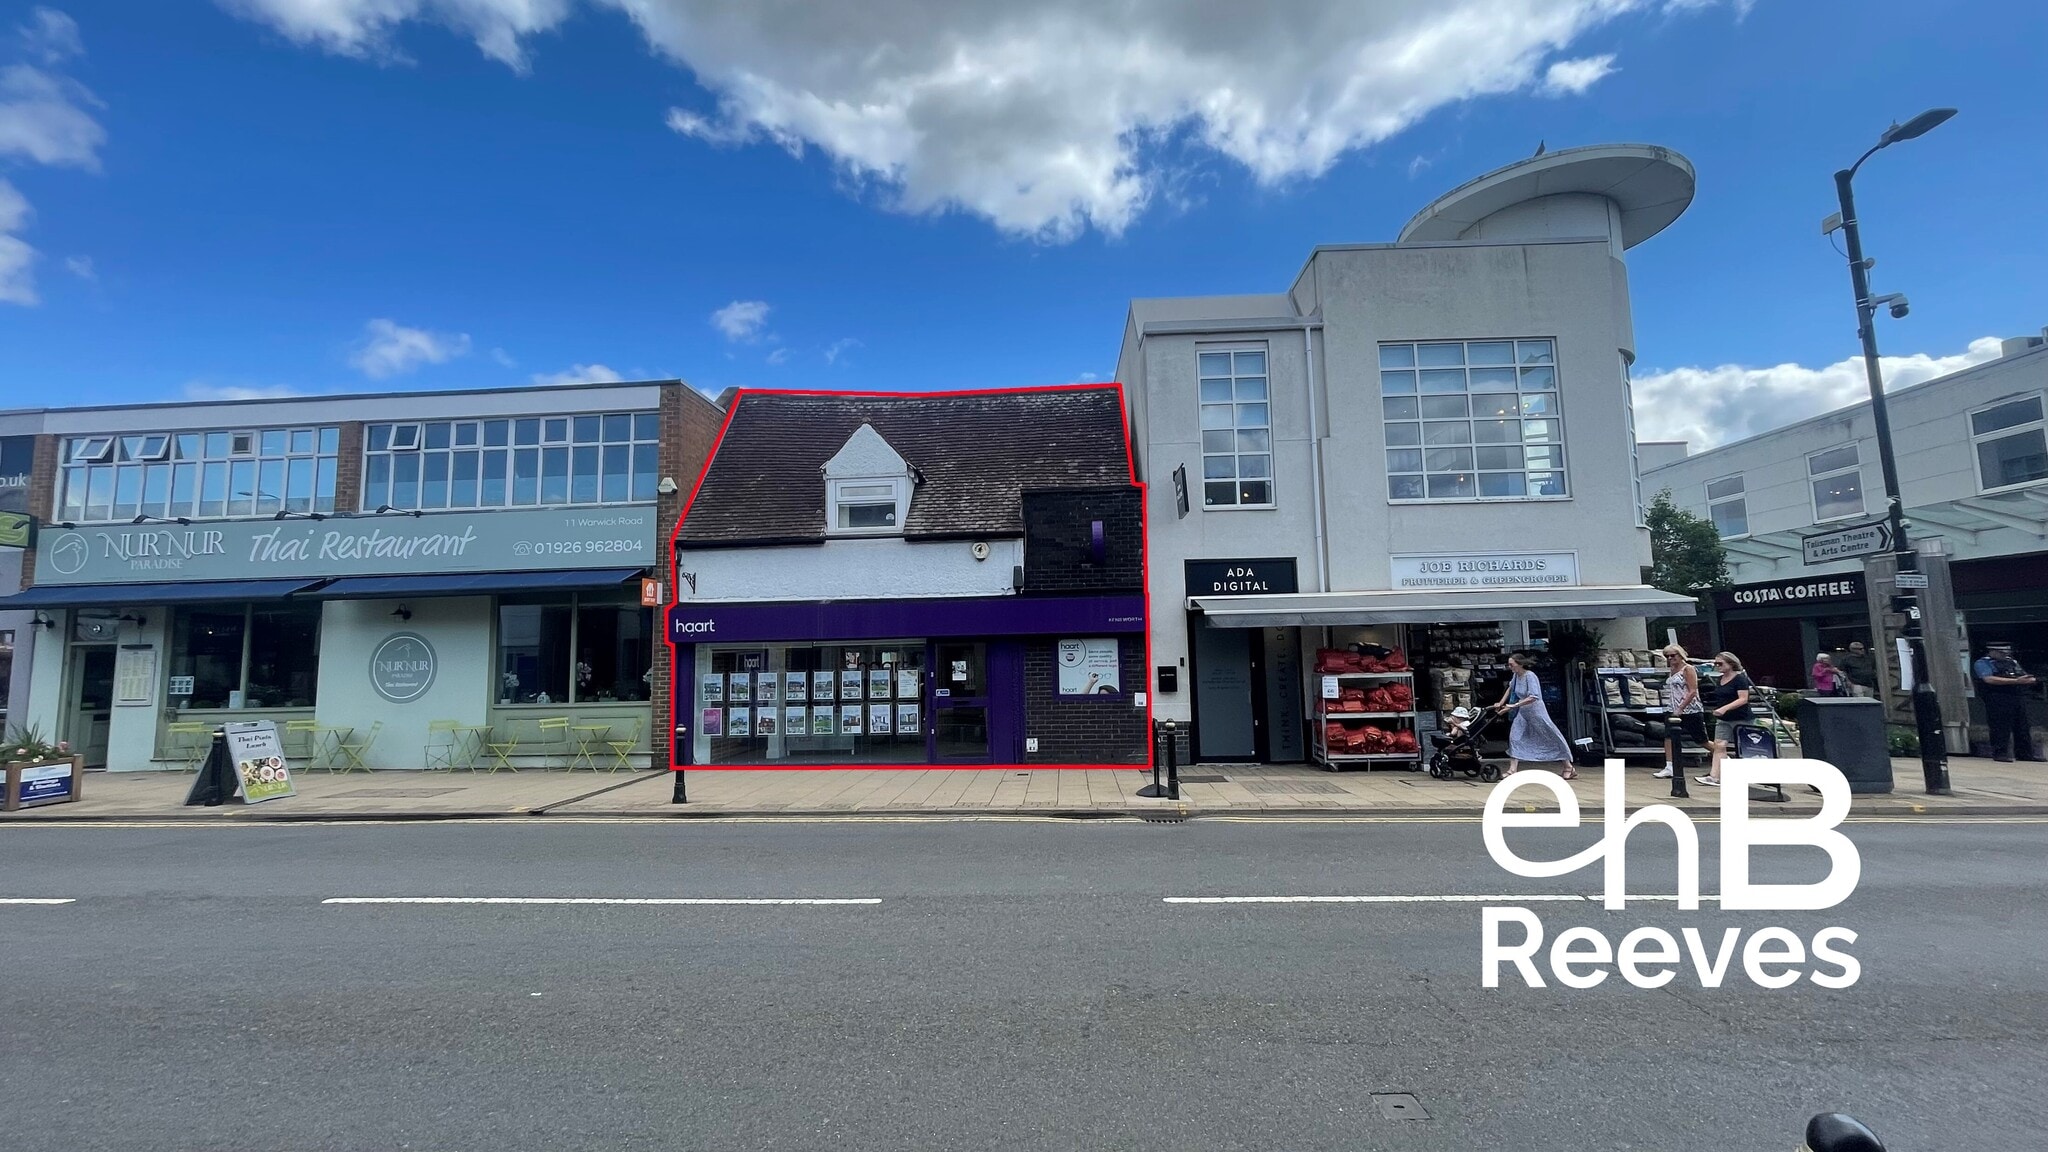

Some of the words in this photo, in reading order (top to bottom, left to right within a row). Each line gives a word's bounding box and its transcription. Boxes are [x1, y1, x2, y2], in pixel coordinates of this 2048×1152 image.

[565, 519, 575, 527] 11
[578, 517, 617, 527] Warwick
[618, 516, 643, 526] Road
[249, 526, 316, 562] Thai
[318, 525, 477, 560] Restaurant
[534, 541, 582, 554] 01926
[585, 539, 643, 553] 962804
[1805, 537, 1841, 549] Talisman
[1842, 530, 1875, 543] Theatre
[1821, 547, 1839, 557] Arts
[1840, 542, 1869, 553] Centre
[130, 558, 183, 570] PARADISE
[1420, 560, 1452, 573] JOE
[1459, 558, 1547, 571] RICHARDS
[1226, 567, 1254, 577] ADA
[1213, 581, 1269, 592] DIGITAL
[1401, 577, 1467, 586] FRUITERER
[1470, 577, 1479, 585] &
[1482, 575, 1569, 585] GREENGROCER
[1734, 587, 1780, 604] COSTA
[1785, 580, 1851, 599] COFFEE
[675, 619, 715, 634] haart
[1060, 642, 1079, 650] haart
